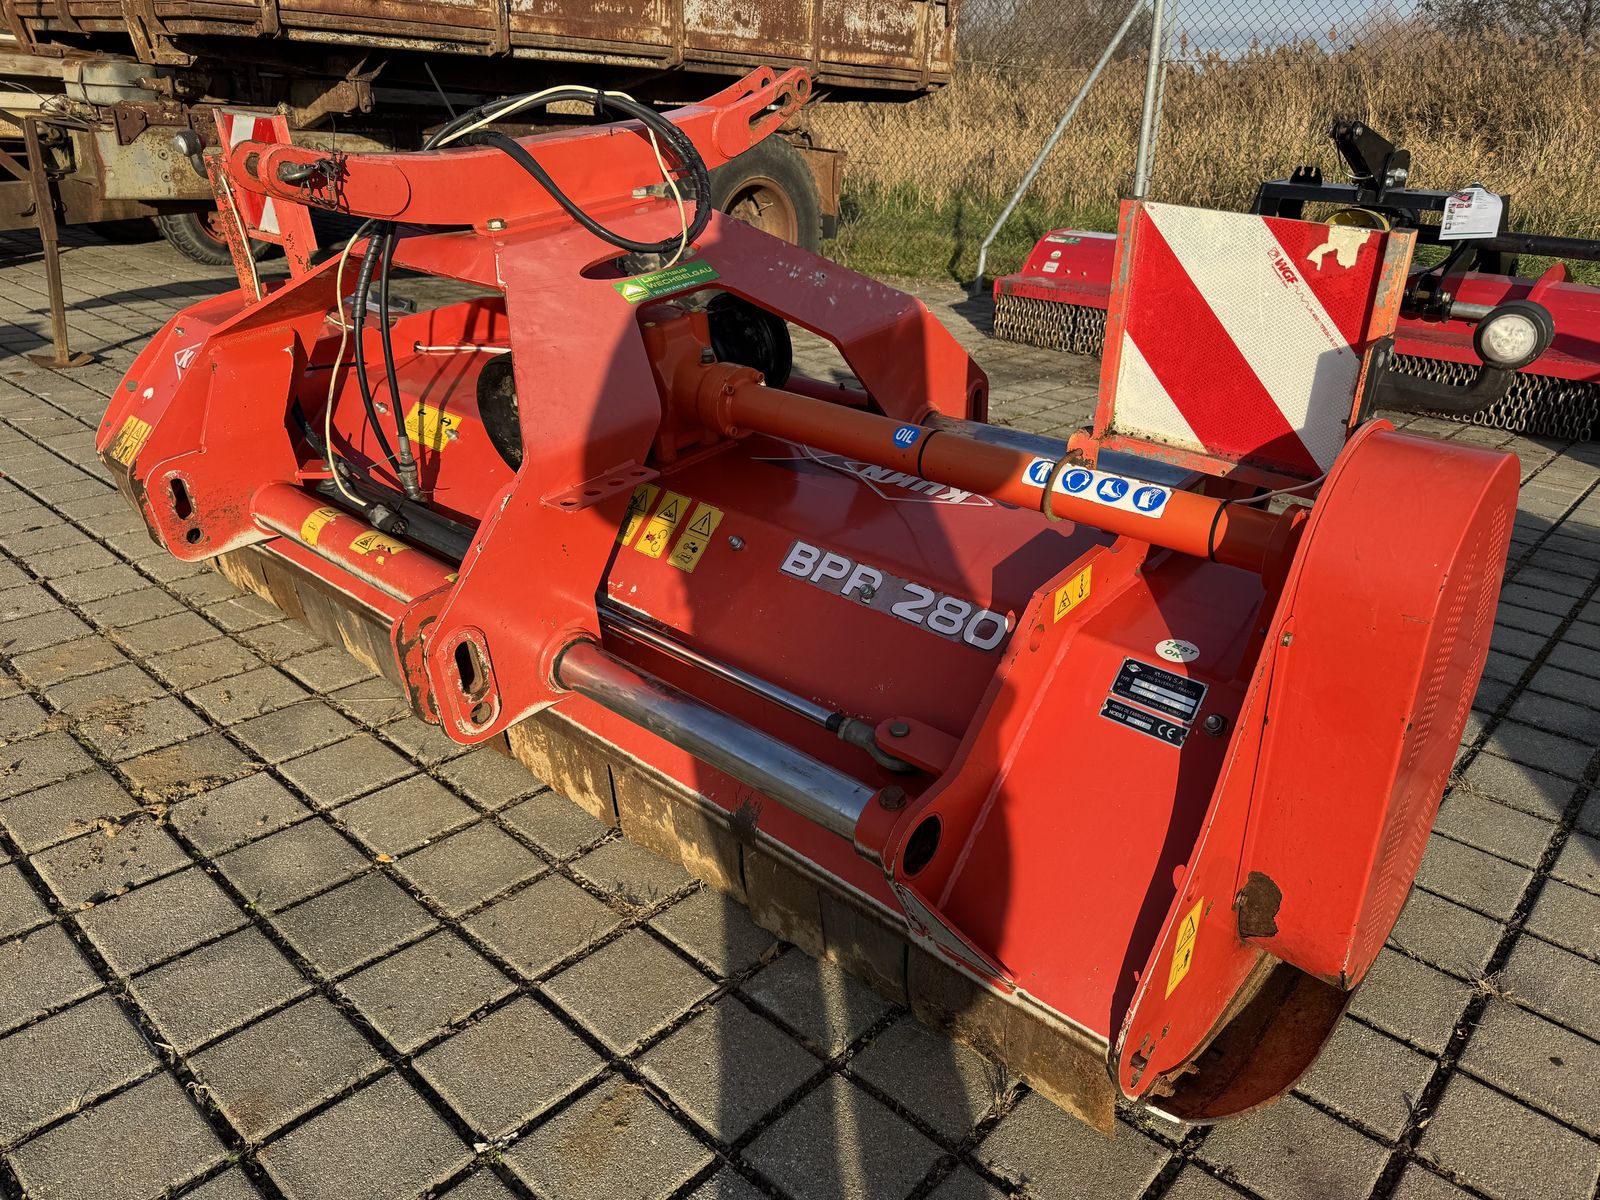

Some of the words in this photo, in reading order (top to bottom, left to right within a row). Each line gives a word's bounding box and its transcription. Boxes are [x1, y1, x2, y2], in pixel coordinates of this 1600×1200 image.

[640, 267, 688, 283] Lagerhaus
[646, 266, 713, 289] WECHSELGAU
[1274, 258, 1298, 283] WGF
[896, 428, 915, 444] OIL
[780, 541, 883, 605] BPR
[891, 583, 1009, 650] 280
[1164, 649, 1182, 659] OK
[1165, 641, 1198, 655] TEST
[1154, 671, 1173, 682] KUHN
[1178, 686, 1196, 696] FRANCE
